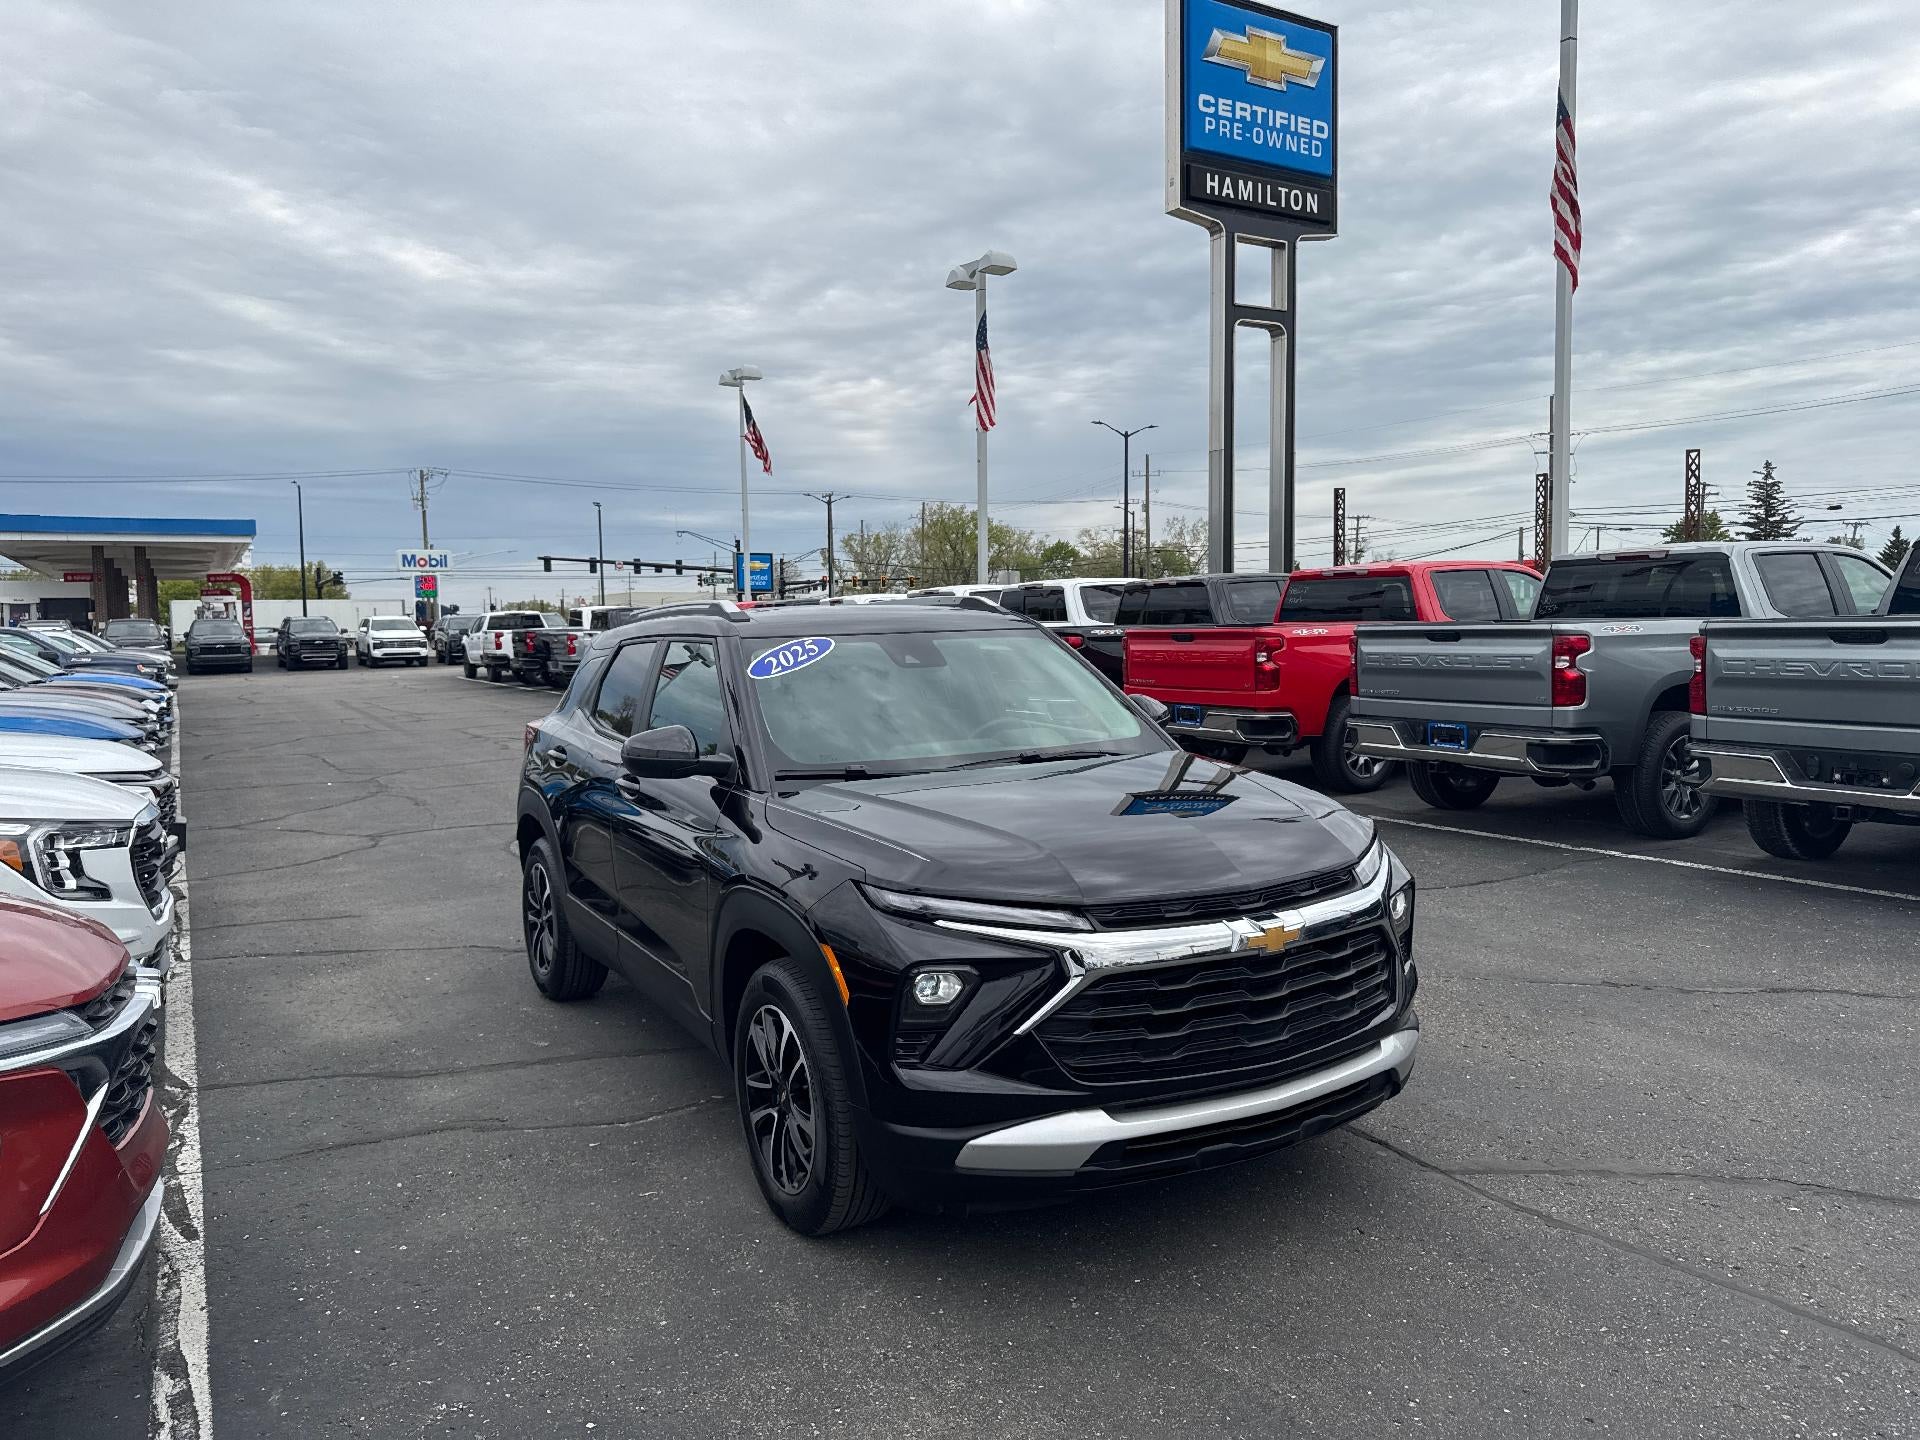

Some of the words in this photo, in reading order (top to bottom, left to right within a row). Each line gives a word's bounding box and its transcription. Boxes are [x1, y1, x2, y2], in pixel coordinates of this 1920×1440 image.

[1198, 93, 1329, 139] CERTIFIED
[1204, 117, 1322, 158] PRE-OWNED
[1206, 172, 1318, 214] HAMILTON
[402, 554, 448, 568] Mobil
[764, 640, 819, 674] 2025
[1365, 653, 1534, 669] CHEVROLET
[1722, 658, 1920, 678] CHEVRO
[1711, 705, 1780, 715] SILVERADO
